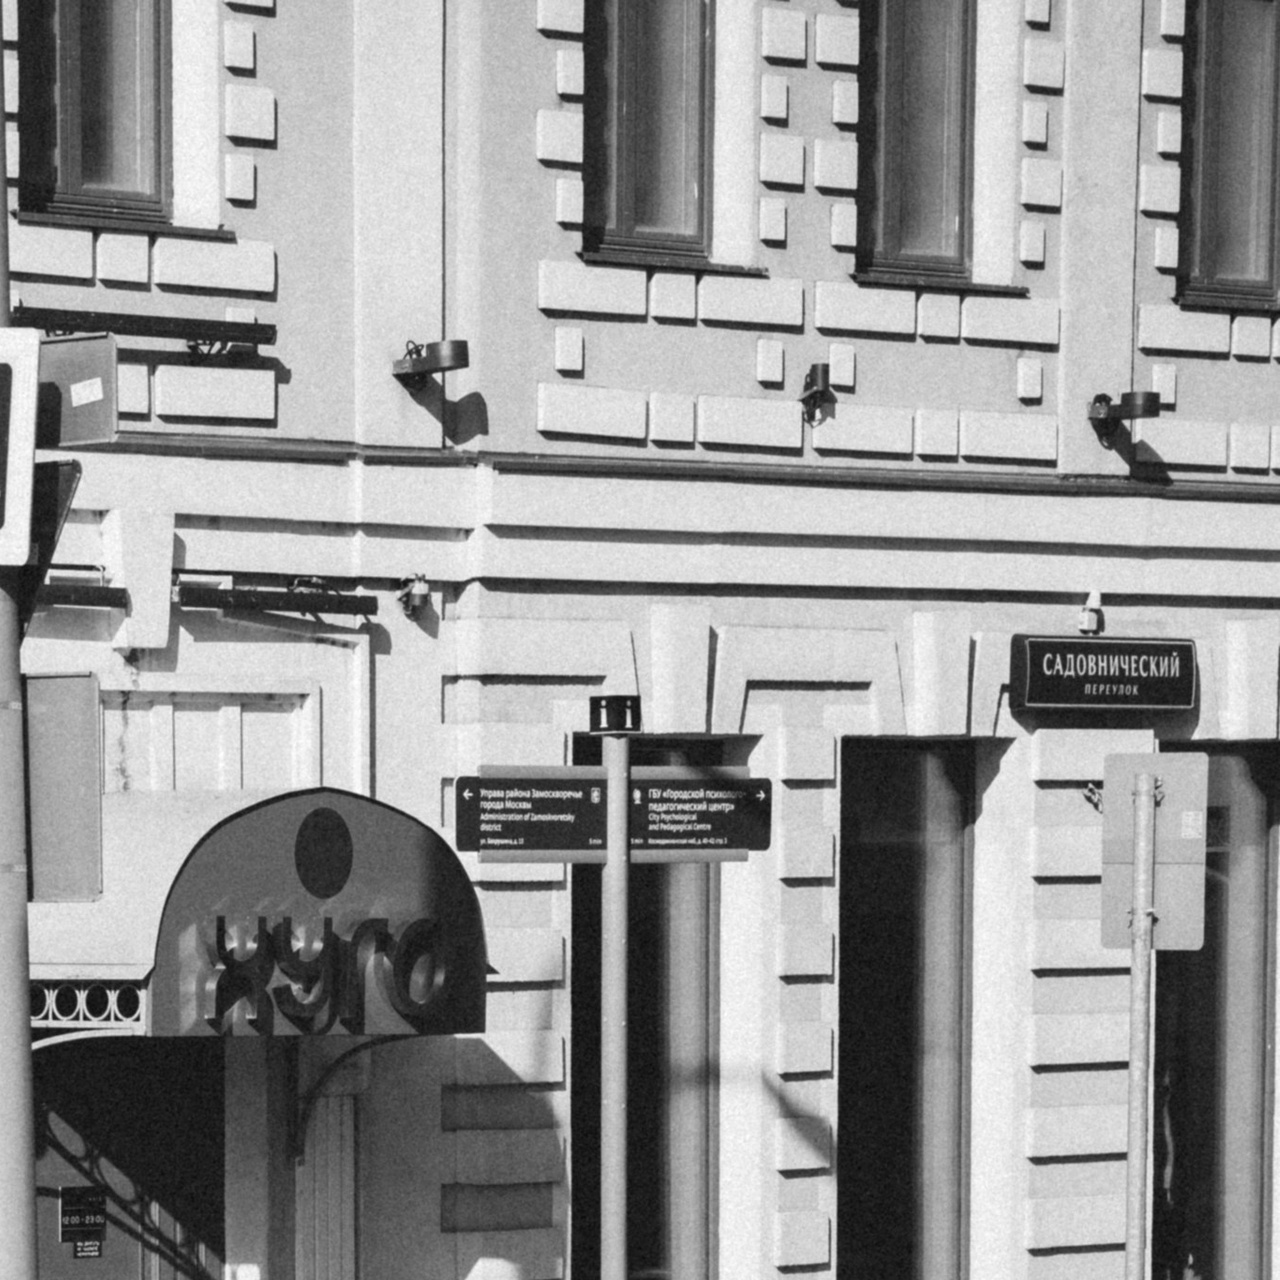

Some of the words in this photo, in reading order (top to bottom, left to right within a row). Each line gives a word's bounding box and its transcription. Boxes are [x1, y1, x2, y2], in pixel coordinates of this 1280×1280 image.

[1042, 651, 1181, 679] САДОВНИЧЕСКИЙ
[1084, 683, 1140, 696] ПЕРЕУЛОК
[479, 788, 504, 800] Управа
[505, 787, 531, 800] района
[531, 788, 583, 800] Замоскворечье
[648, 788, 662, 799] ГБУ
[479, 801, 504, 811] города
[505, 800, 532, 810] Москвы
[648, 801, 707, 812] педагогический
[480, 812, 524, 821] Administration
[648, 812, 660, 823] City
[660, 812, 698, 823] Psychological
[480, 823, 502, 831] district
[648, 822, 659, 831] and
[660, 822, 693, 833] Pedagogical
